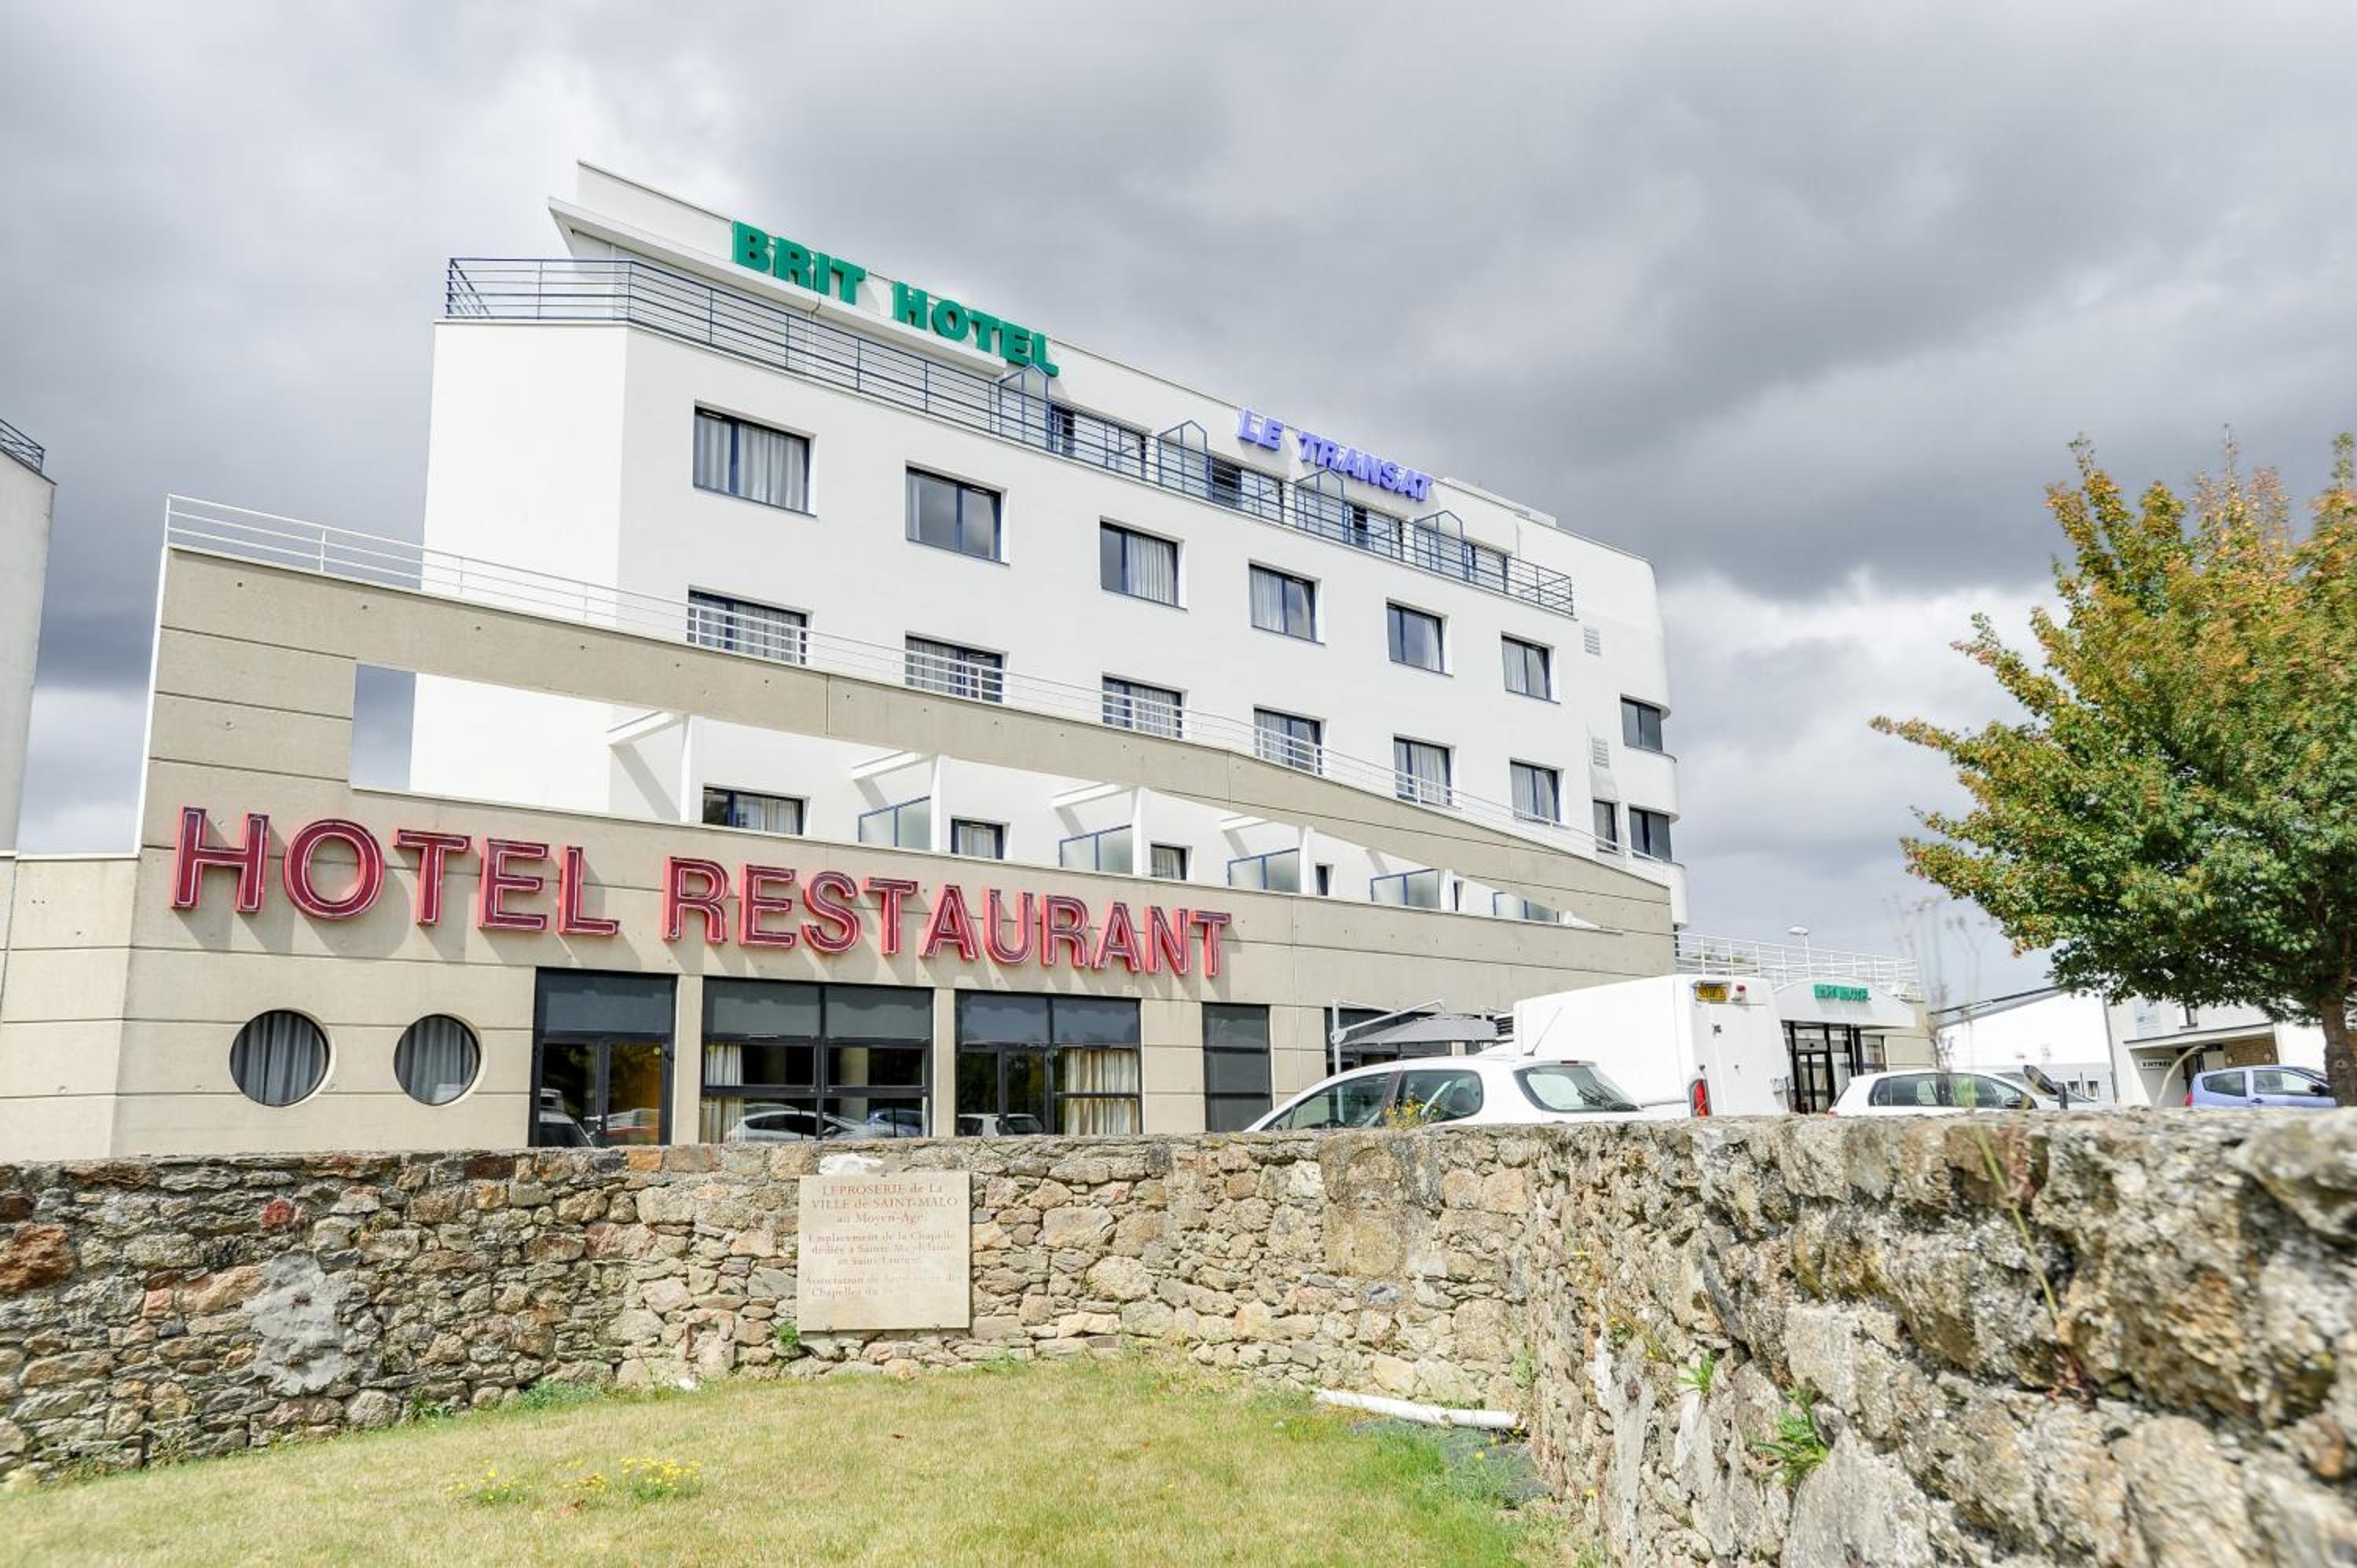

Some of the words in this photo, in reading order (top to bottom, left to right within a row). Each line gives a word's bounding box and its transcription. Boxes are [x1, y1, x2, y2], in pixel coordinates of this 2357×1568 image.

[731, 221, 867, 306] BRIT
[892, 280, 1060, 378] HOTEL
[1237, 408, 1284, 452] LE
[1297, 430, 1434, 501] TRANSAT
[170, 805, 620, 936] HOTEL
[662, 855, 1232, 977] RESTAURANT
[812, 1198, 851, 1210] VILLE
[853, 1198, 868, 1208] de
[873, 1196, 958, 1208] SAINT-MALO
[909, 1181, 924, 1193] de
